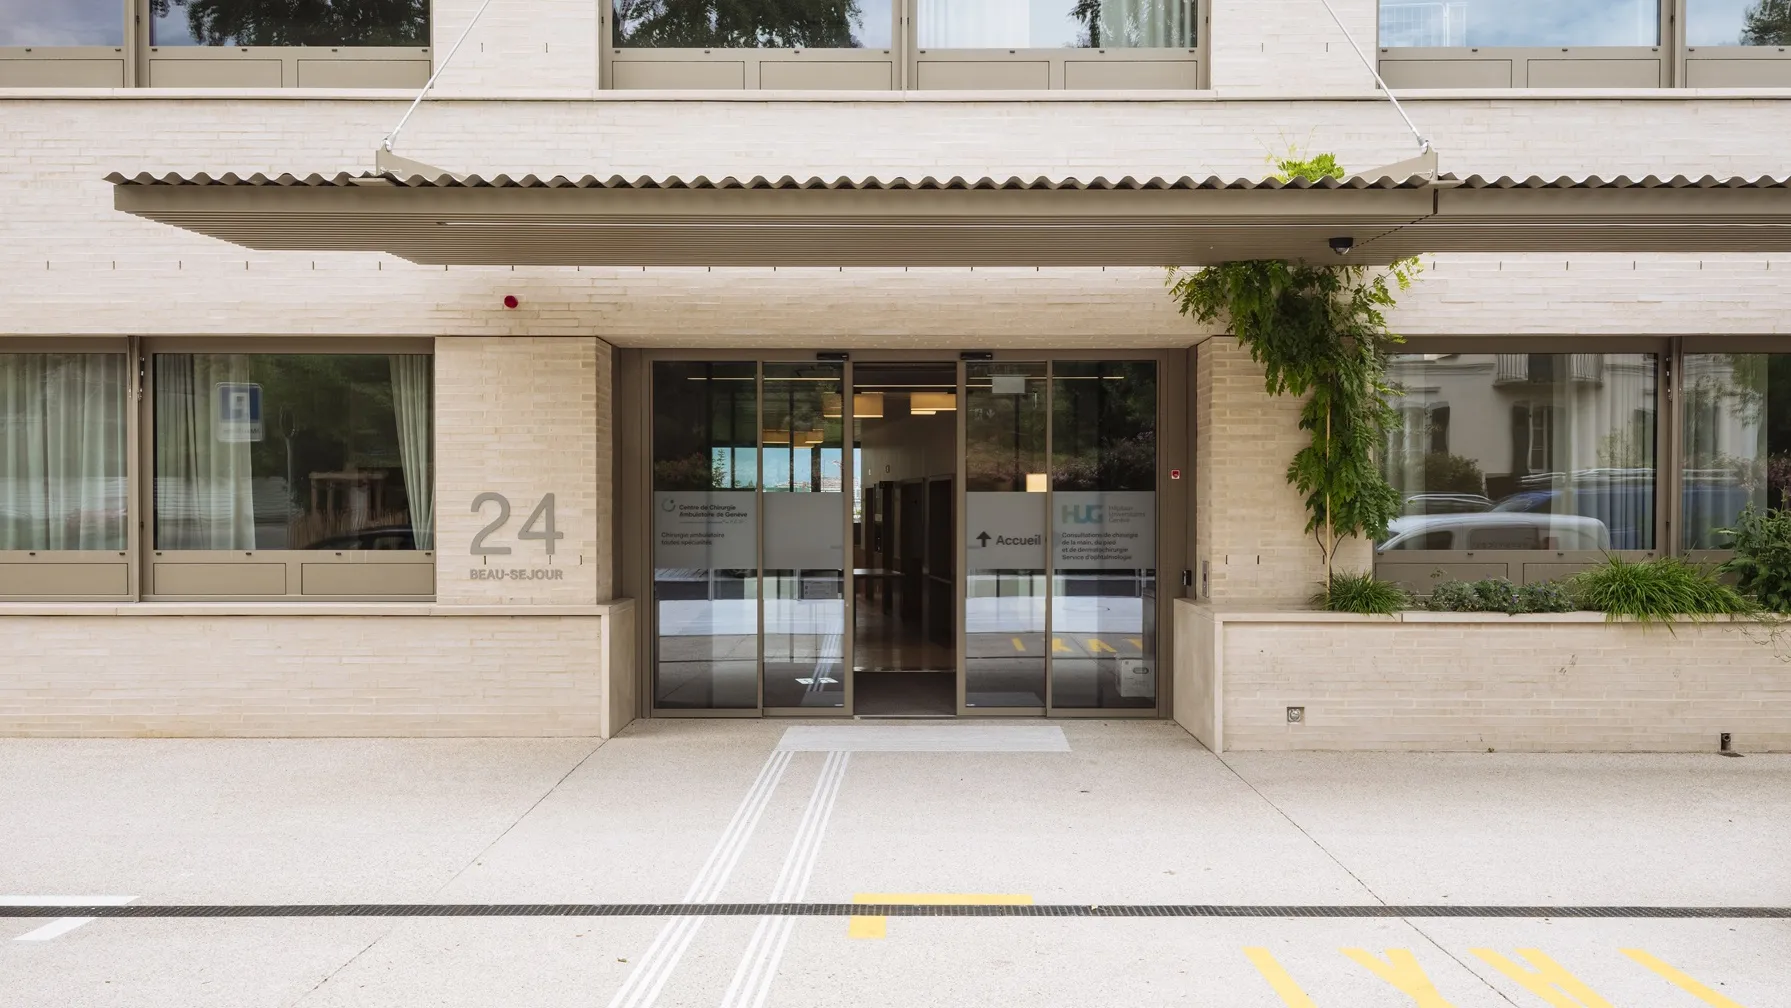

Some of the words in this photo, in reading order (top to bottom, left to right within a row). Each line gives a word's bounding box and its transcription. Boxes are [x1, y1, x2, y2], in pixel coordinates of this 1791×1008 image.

[709, 504, 736, 512] Chirurgie
[1061, 504, 1104, 524] HUG
[469, 491, 564, 556] 24
[995, 534, 1042, 546] Accueil
[1103, 539, 1117, 547] pied
[470, 569, 563, 580] BEAU-SEJOUR
